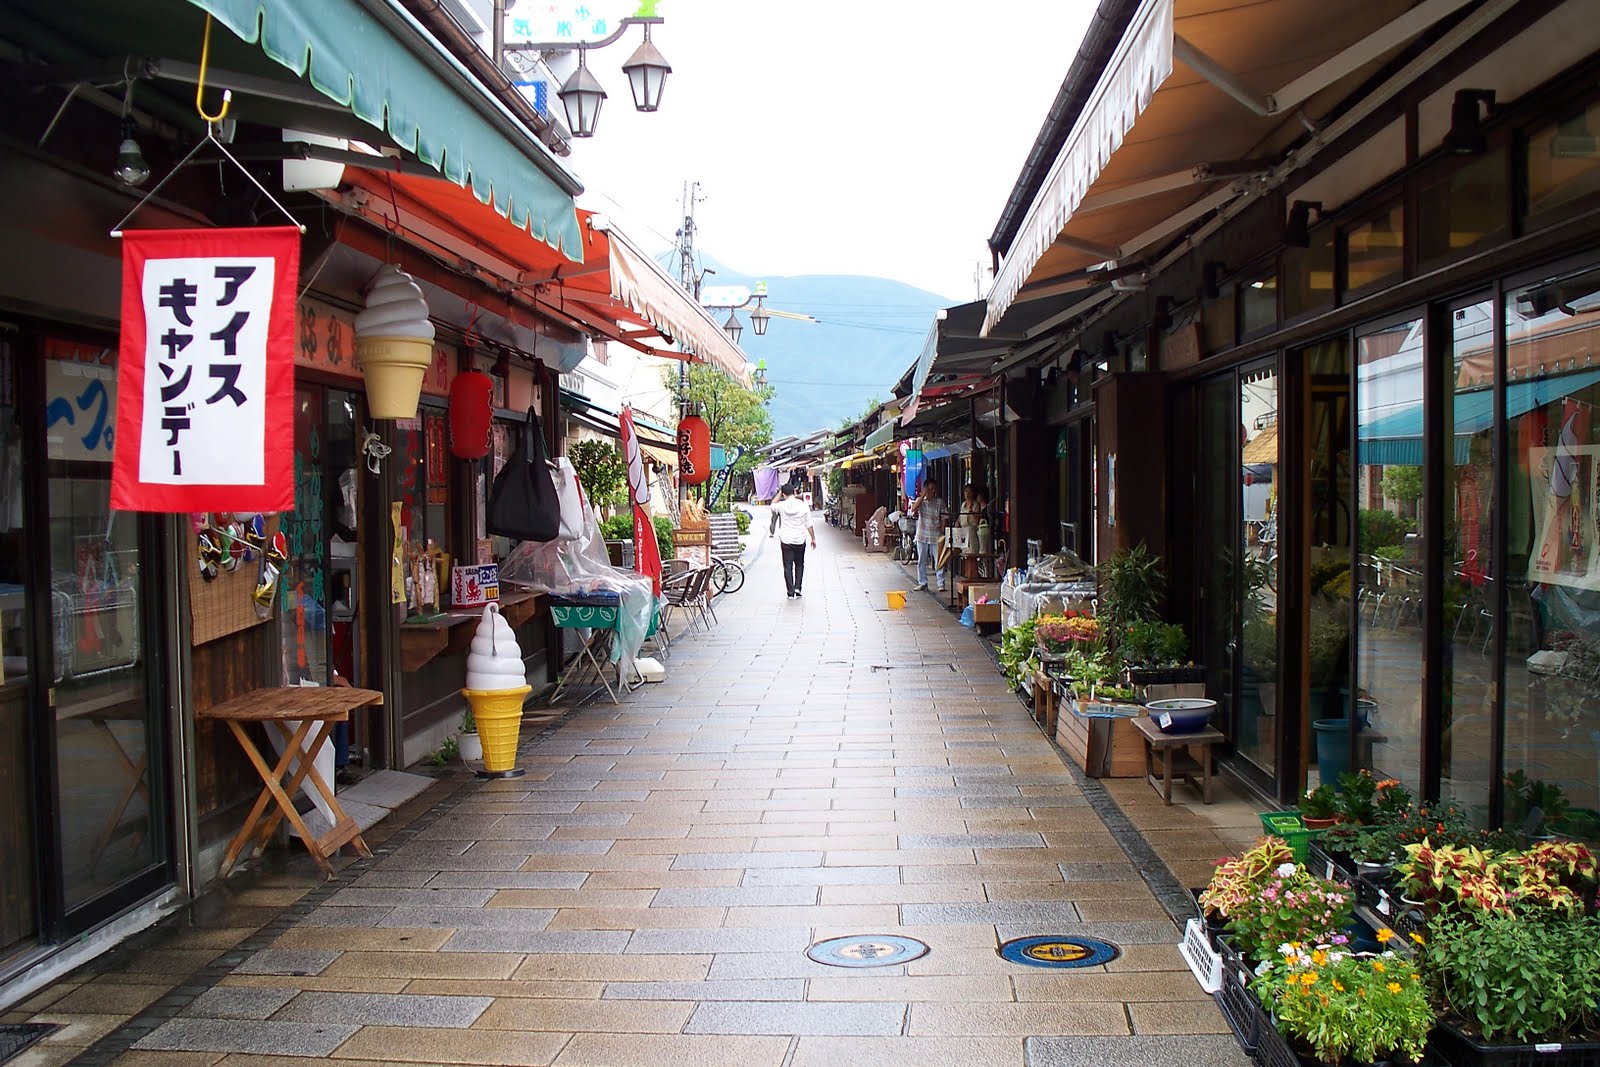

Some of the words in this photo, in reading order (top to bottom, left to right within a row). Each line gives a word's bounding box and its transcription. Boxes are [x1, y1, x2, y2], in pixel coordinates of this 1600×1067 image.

[158, 278, 198, 476] キャンデー
[205, 265, 256, 408] アイス
[676, 533, 705, 541] SWEET
